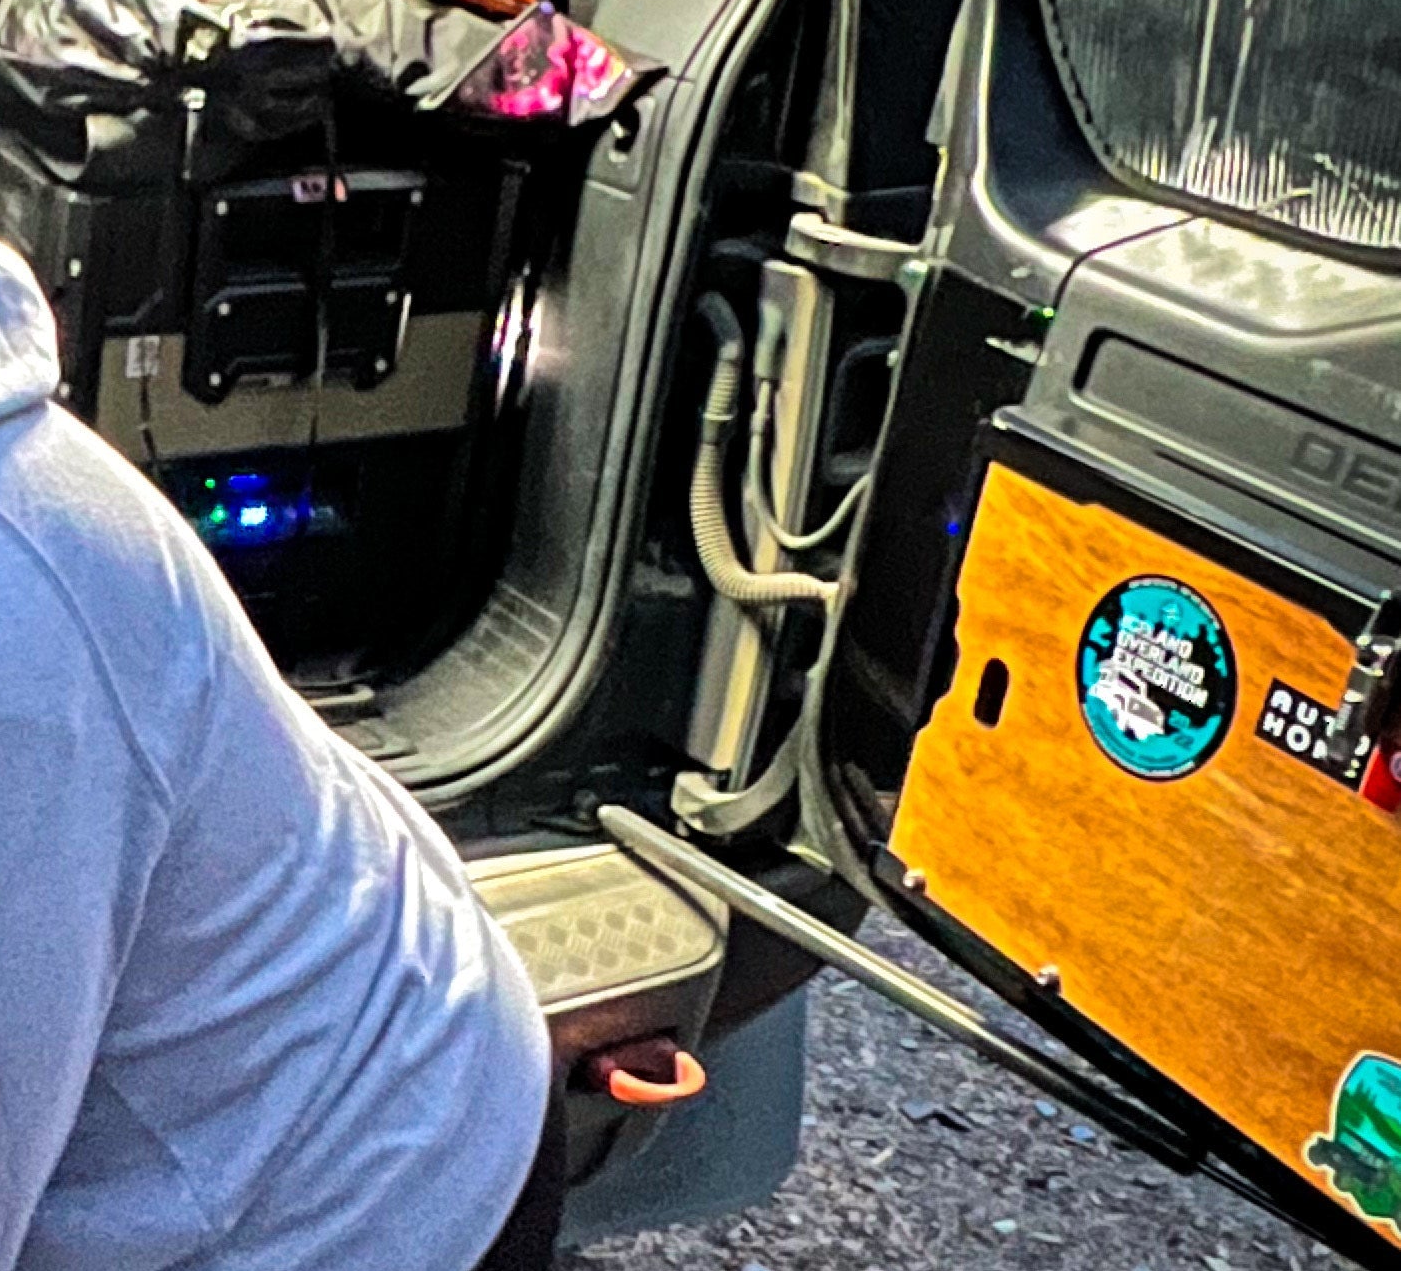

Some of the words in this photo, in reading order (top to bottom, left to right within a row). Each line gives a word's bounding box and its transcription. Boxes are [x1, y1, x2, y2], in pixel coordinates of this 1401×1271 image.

[1291, 431, 1401, 510] DE
[1112, 646, 1209, 709] EXPEDITION
[1117, 630, 1206, 685] OVERLAND
